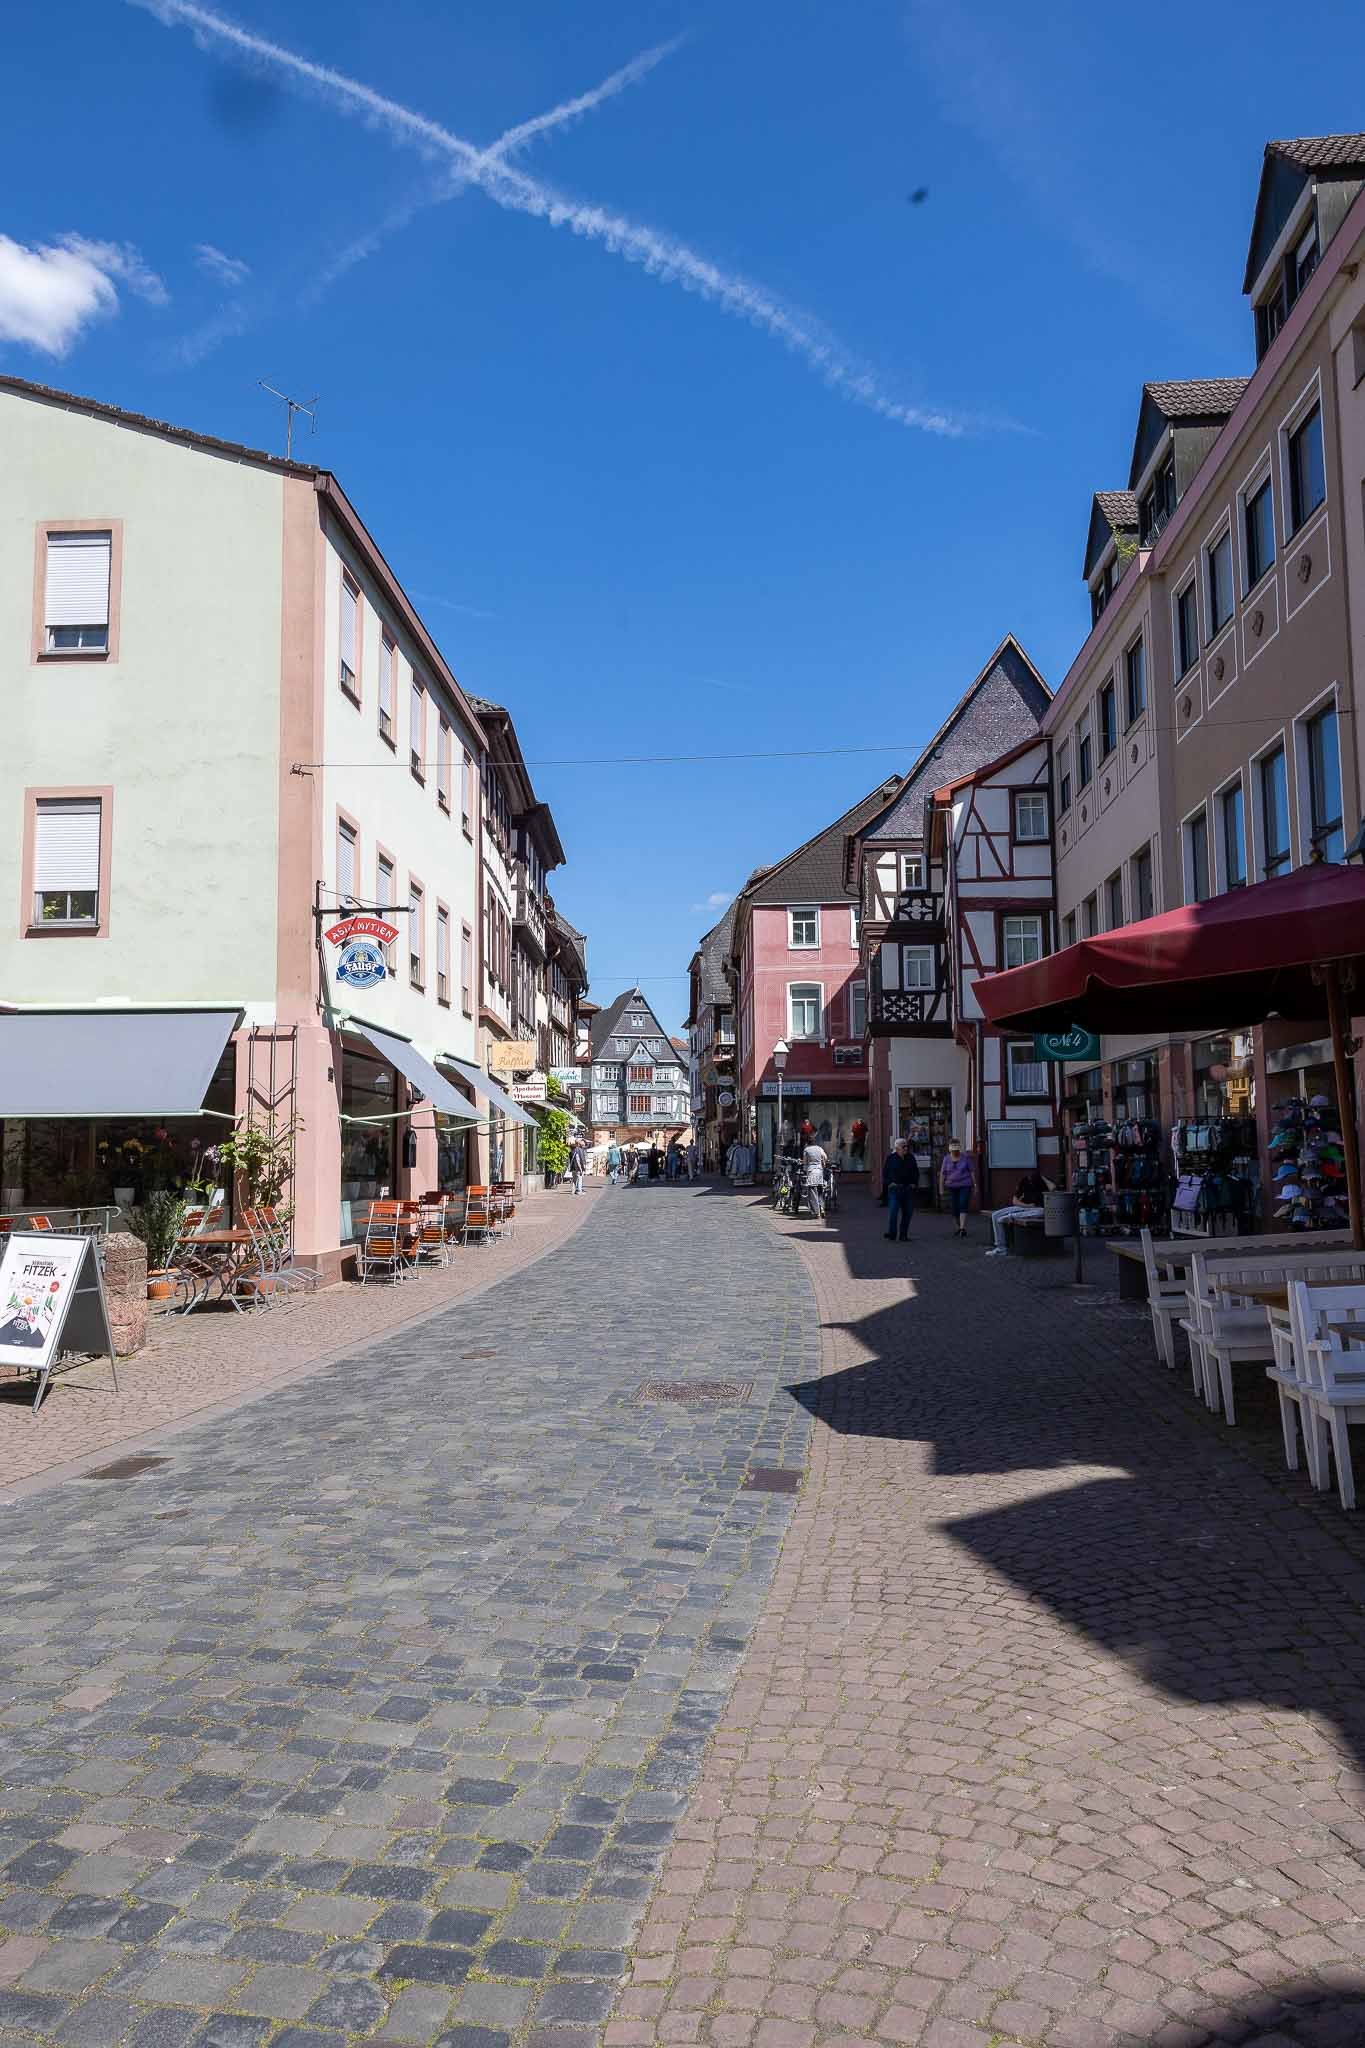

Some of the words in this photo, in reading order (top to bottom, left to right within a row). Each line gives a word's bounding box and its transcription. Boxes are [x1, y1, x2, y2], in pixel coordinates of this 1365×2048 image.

[331, 924, 355, 940] ASIA
[344, 961, 379, 972] FAUST
[23, 1264, 57, 1277] FITZEK
